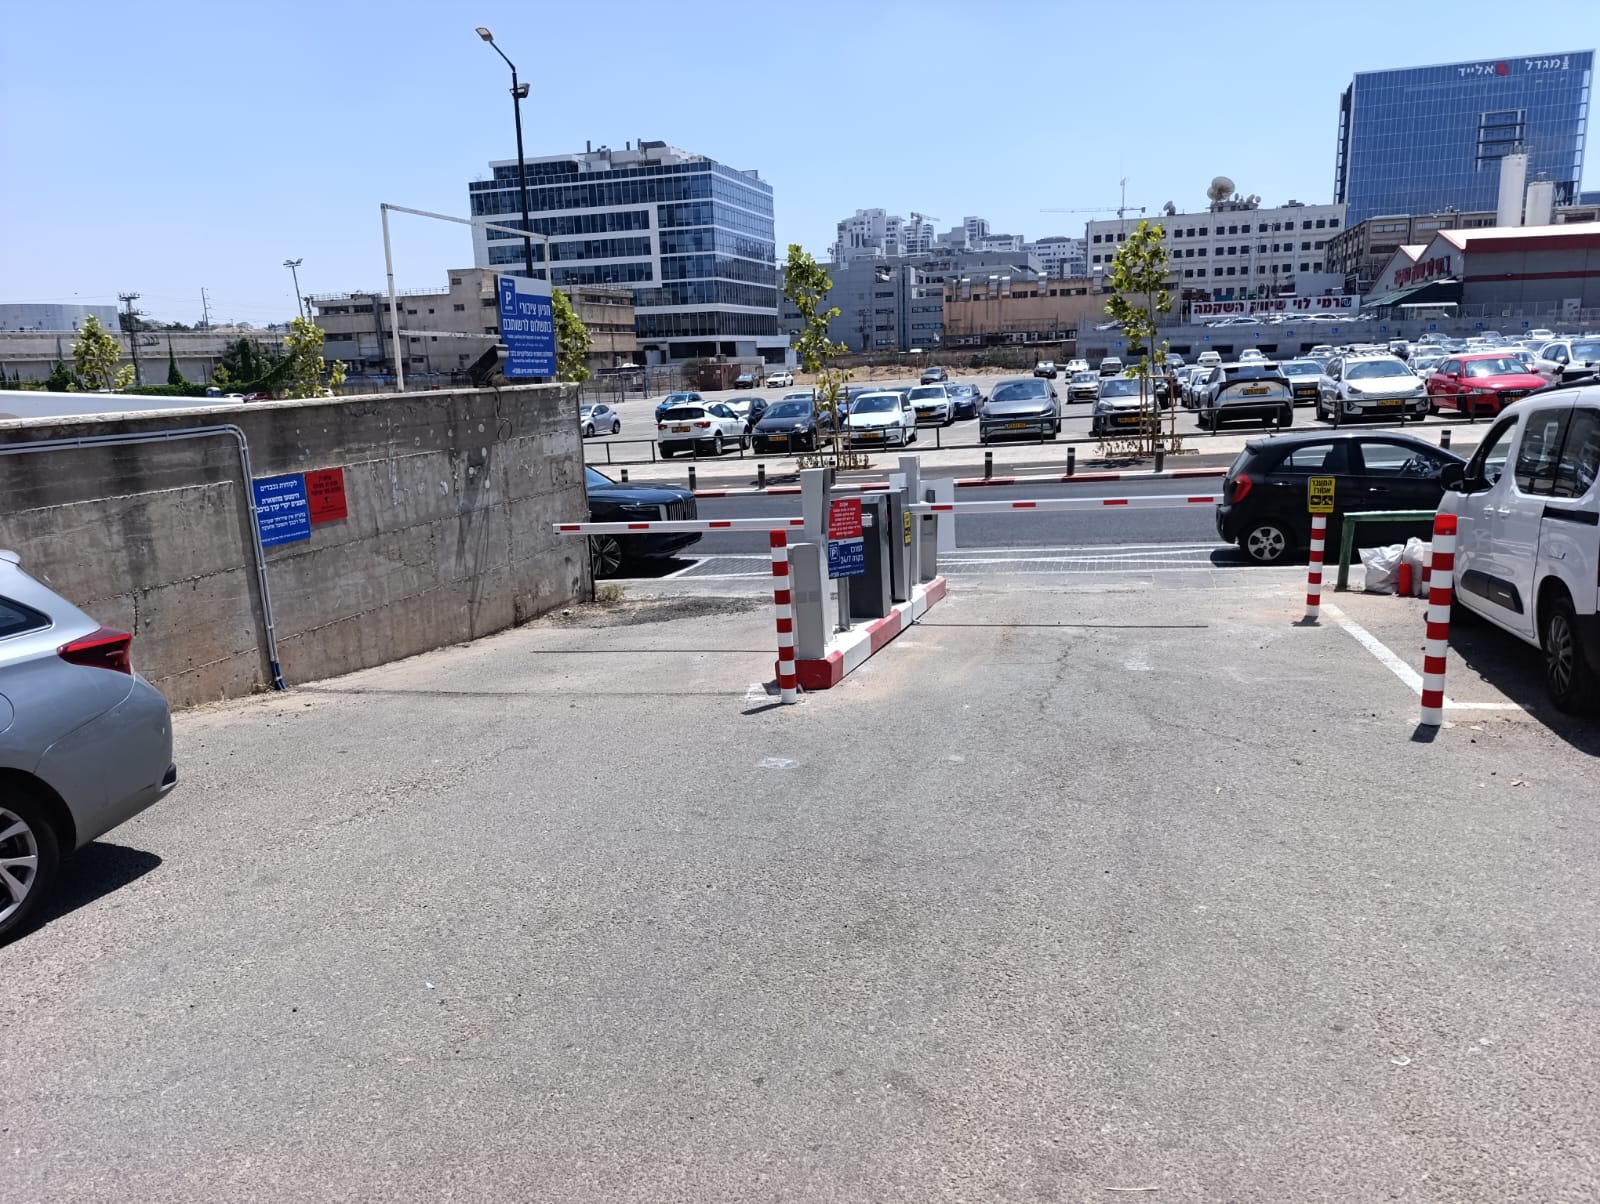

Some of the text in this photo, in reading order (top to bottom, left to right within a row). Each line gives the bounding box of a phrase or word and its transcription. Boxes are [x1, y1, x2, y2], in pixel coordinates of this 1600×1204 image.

[1458, 64, 1494, 77] אלייד
[1525, 59, 1561, 71] מגדל
[505, 291, 512, 305] P
[519, 302, 551, 318] חניון ציבורי
[1193, 297, 1342, 315] רמי לוי שיווק השקמה
[503, 318, 552, 333] בתשלום לרשותכם
[279, 480, 297, 488] לקוחות
